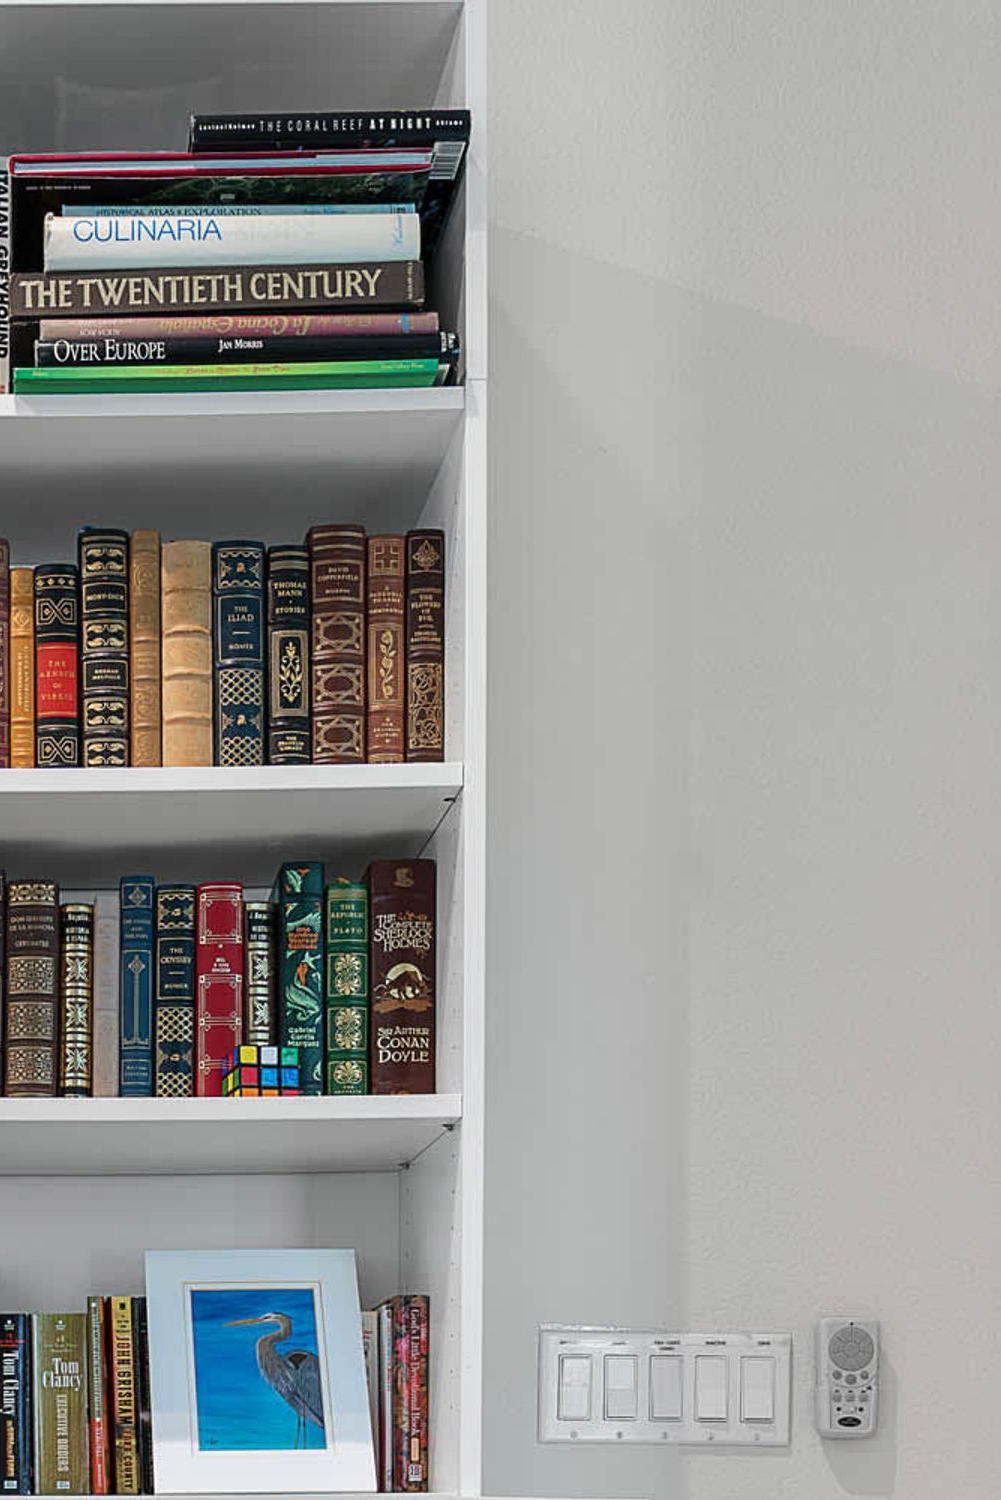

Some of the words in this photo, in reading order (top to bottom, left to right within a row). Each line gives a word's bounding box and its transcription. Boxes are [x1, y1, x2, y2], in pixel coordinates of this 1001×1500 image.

[259, 121, 283, 133] THE
[287, 120, 328, 132] CORAL
[332, 119, 363, 131] REEF
[369, 118, 385, 130] AT
[73, 219, 222, 242] CULINARIA
[19, 278, 72, 309] THE
[78, 273, 243, 306] TWENTIETH
[250, 268, 383, 301] CENTURY
[54, 338, 100, 362] OVER
[105, 338, 165, 361] EUROPE
[233, 338, 264, 351] MORRIS
[274, 581, 306, 590] THOMAS
[278, 589, 302, 598] MANN
[234, 605, 248, 613] THE
[275, 606, 305, 614] STORIES
[228, 613, 254, 623] ILIAD
[376, 914, 397, 929] THE
[383, 920, 432, 931] COMPLETE
[373, 928, 433, 943] SHERLOCK
[383, 938, 430, 952] HOLMES
[161, 957, 191, 965] ODYSSEY
[394, 1026, 429, 1036] ARTHUR
[377, 1036, 429, 1049] CONAN
[379, 1049, 429, 1063] DOYLE
[117, 1337, 130, 1366] JOHN
[3, 1350, 19, 1375] Tom
[51, 1358, 79, 1374] Tom
[42, 1371, 83, 1391] Clancy
[409, 1362, 420, 1412] Devotional
[0, 1379, 19, 1416] Clancy
[117, 1371, 133, 1425] GRISHAM
[409, 1413, 420, 1436] Book
[57, 1438, 68, 1472] ORDERS
[124, 1456, 134, 1489] COUNTY
